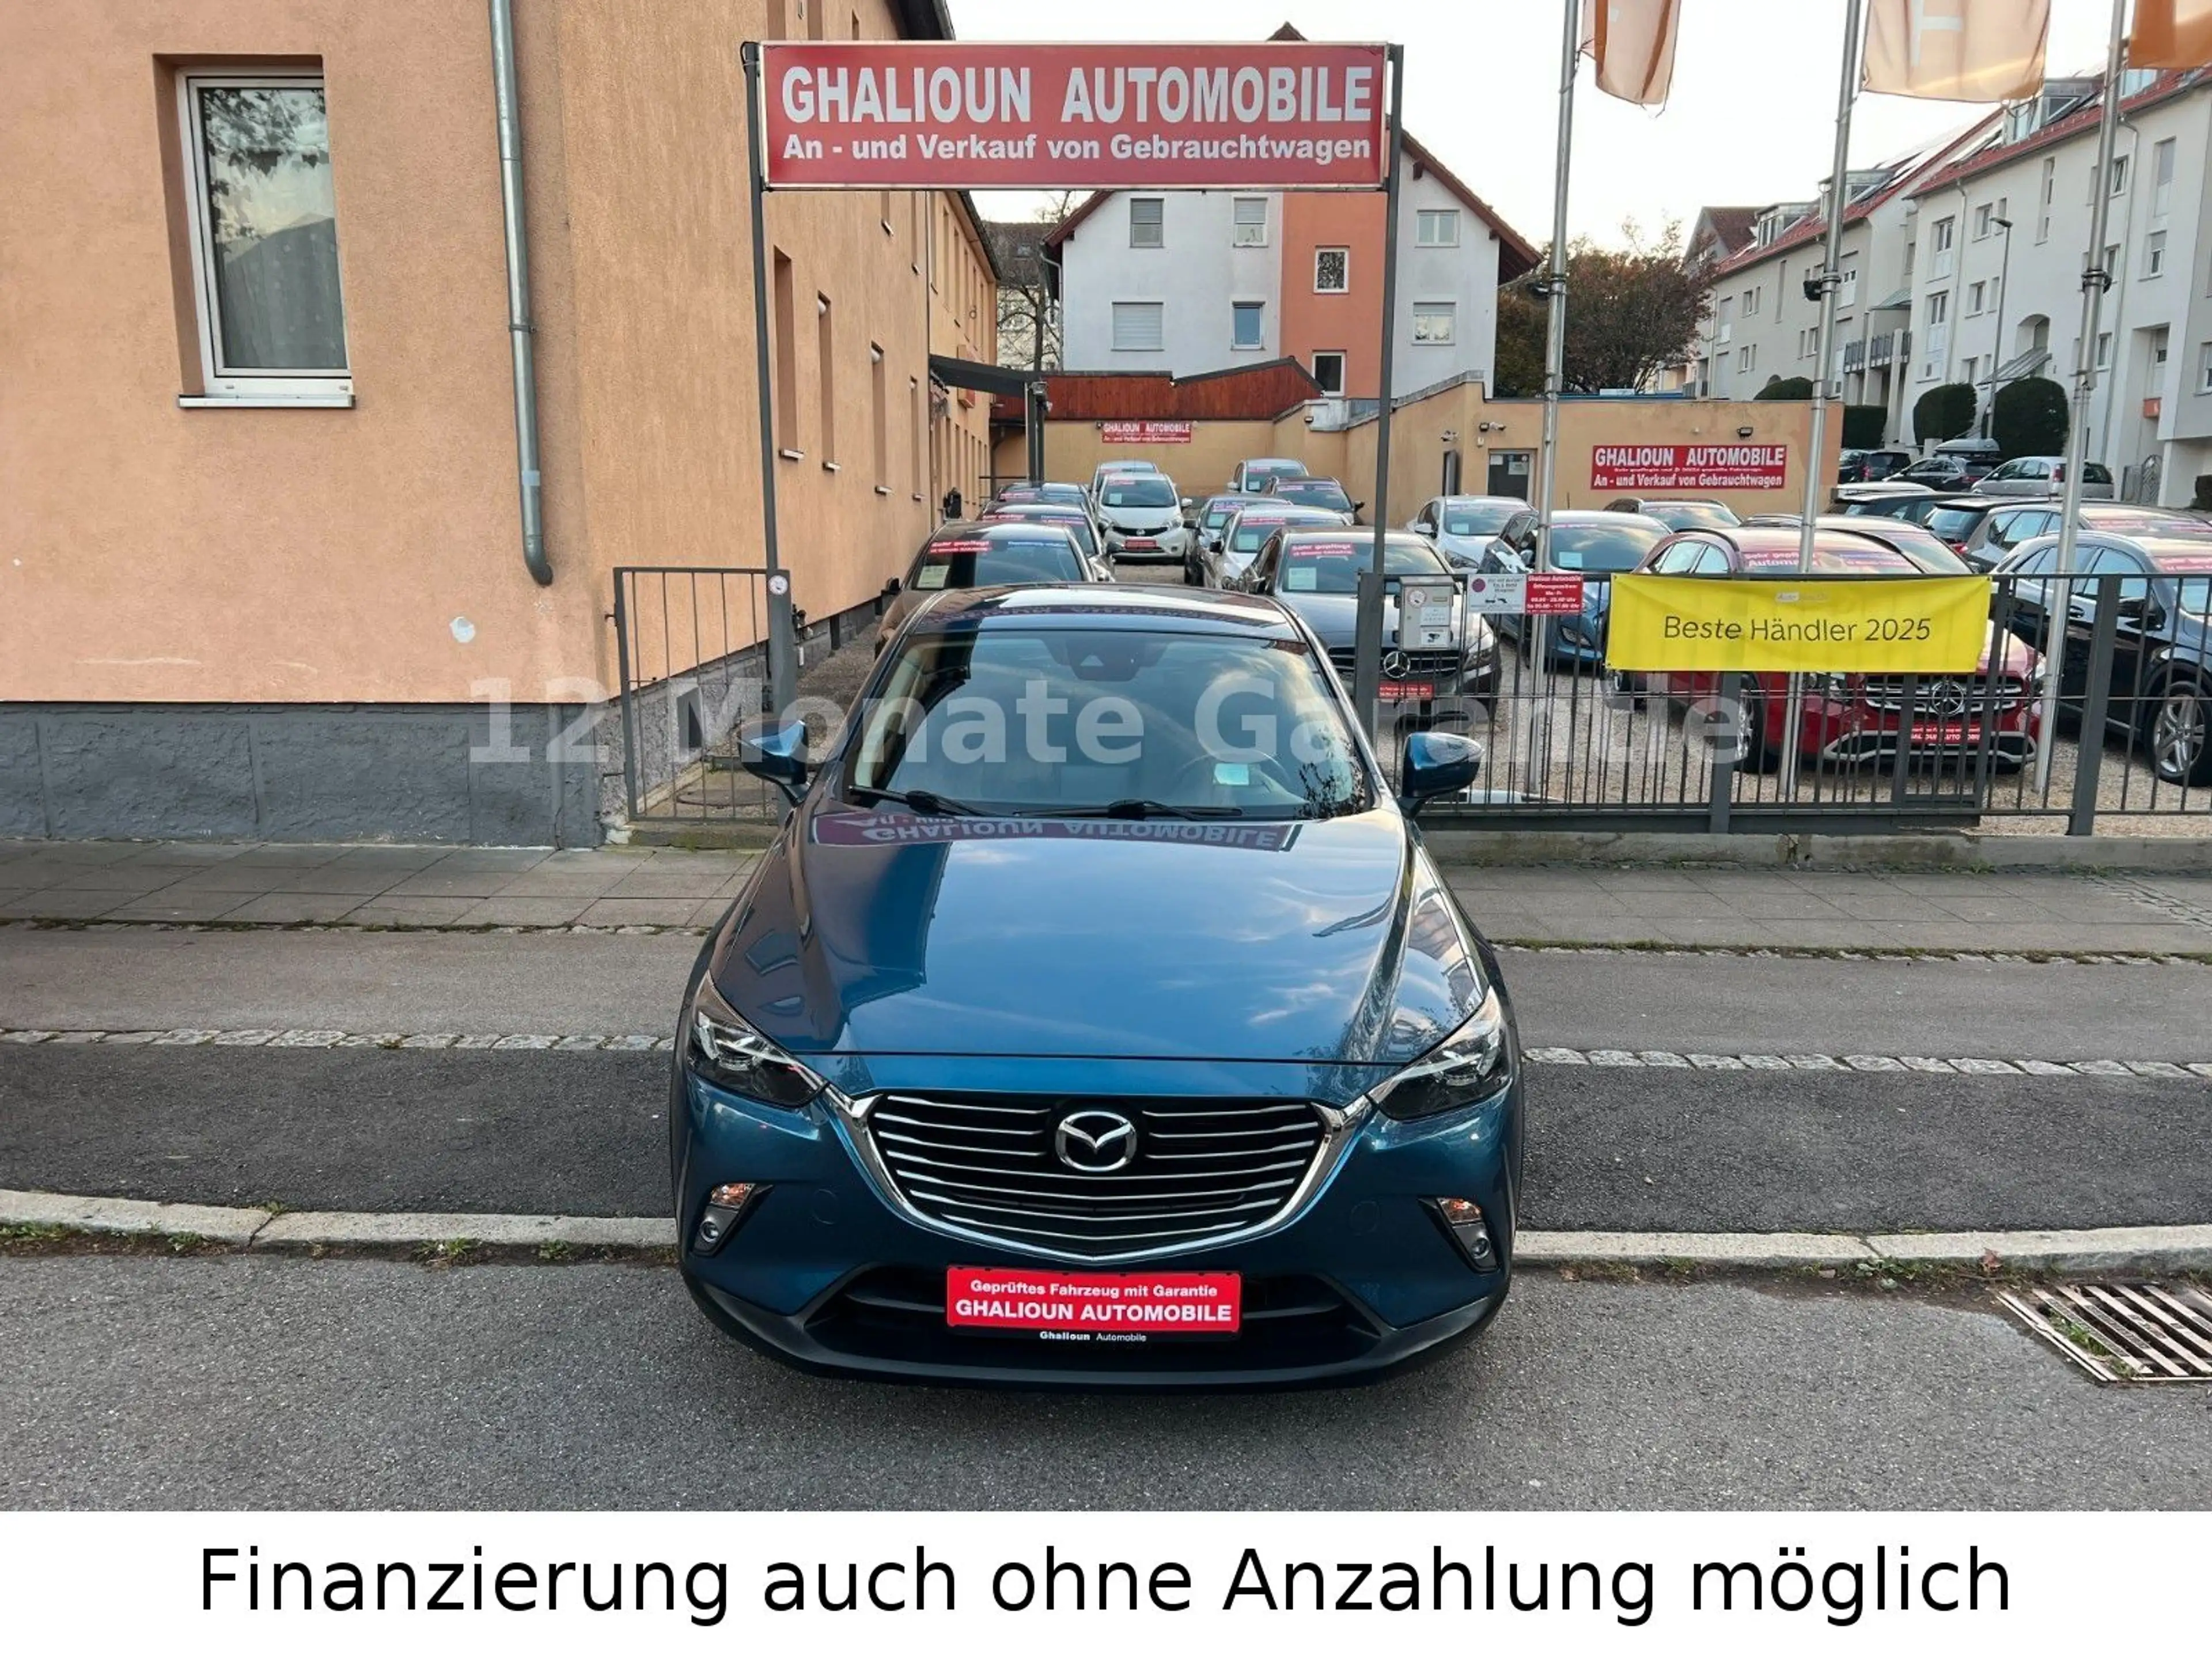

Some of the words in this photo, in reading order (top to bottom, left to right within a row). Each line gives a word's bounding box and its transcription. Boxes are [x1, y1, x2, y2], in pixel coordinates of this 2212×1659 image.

[782, 66, 1031, 123] GHALIOUN
[1060, 66, 1372, 123] AUTOMOBILE
[783, 134, 823, 159] An
[852, 134, 907, 159] und
[916, 134, 1037, 160] Verkauf
[1047, 139, 1099, 160] von
[1110, 134, 1370, 165] Gebrauchtwagen
[1595, 448, 1674, 466] GHALIOUN
[1685, 447, 1784, 466] AUTOMOBILE
[1594, 474, 1607, 486] An
[1616, 474, 1634, 486] und
[1637, 474, 1677, 486] Verkauf
[1679, 476, 1696, 486] von
[1699, 473, 1782, 488] Gebrauchtwagen
[1664, 615, 1743, 639] Beste
[1751, 618, 1857, 642] Händler
[1865, 617, 1931, 641] 2025
[970, 1279, 1046, 1297] Geprüftes
[1050, 1283, 1120, 1299] Fahrzeug
[1124, 1285, 1149, 1297] mit
[1153, 1284, 1218, 1297] Garantie
[955, 1299, 1073, 1320] GHALIOUN
[1080, 1303, 1232, 1322] AUTOMOBILE
[1039, 1330, 1090, 1341] Ghalioun
[1096, 1332, 1147, 1342] Automobile
